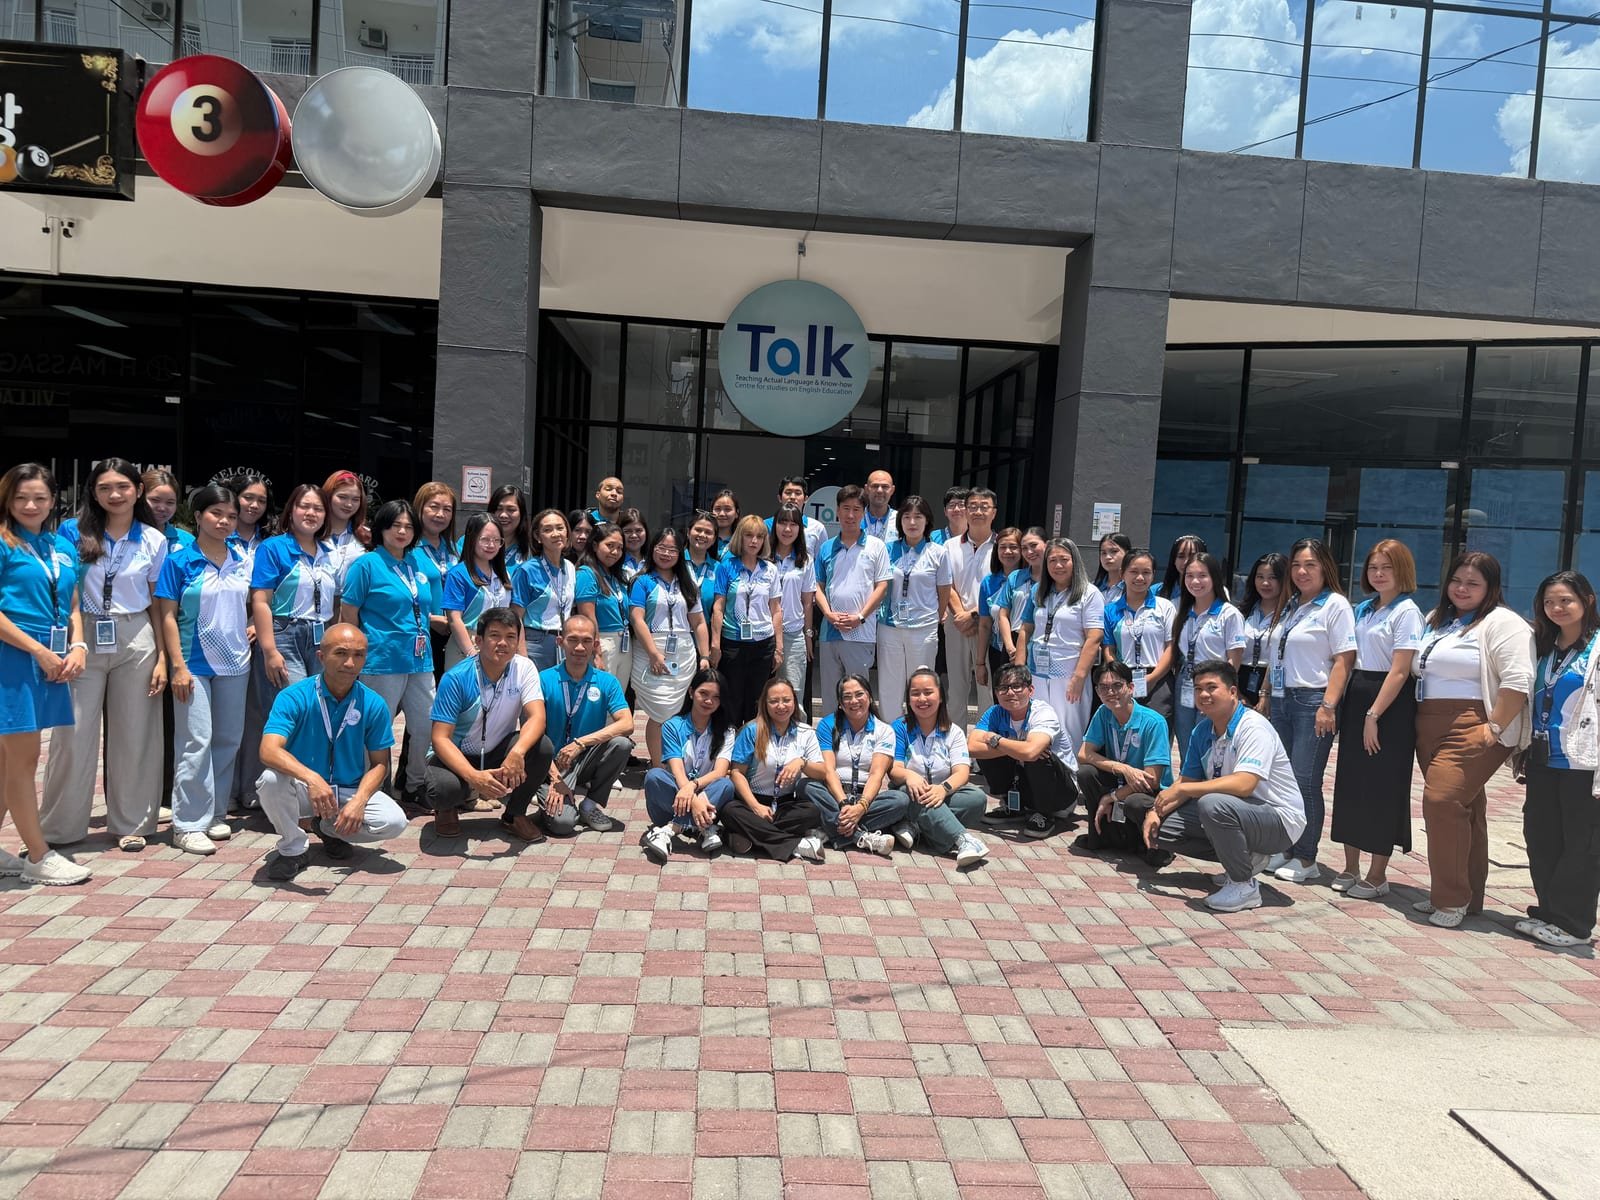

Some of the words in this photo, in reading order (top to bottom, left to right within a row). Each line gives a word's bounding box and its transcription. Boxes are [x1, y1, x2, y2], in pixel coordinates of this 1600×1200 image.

[191, 94, 223, 142] 3
[737, 324, 854, 378] Talk
[735, 374, 762, 384] Teaching
[763, 376, 781, 384] Actual
[783, 378, 814, 388] Language
[820, 380, 853, 388] Know-how
[756, 382, 766, 390] for
[798, 385, 821, 394] English
[821, 387, 853, 395] Education
[208, 465, 273, 488] WELCOME
